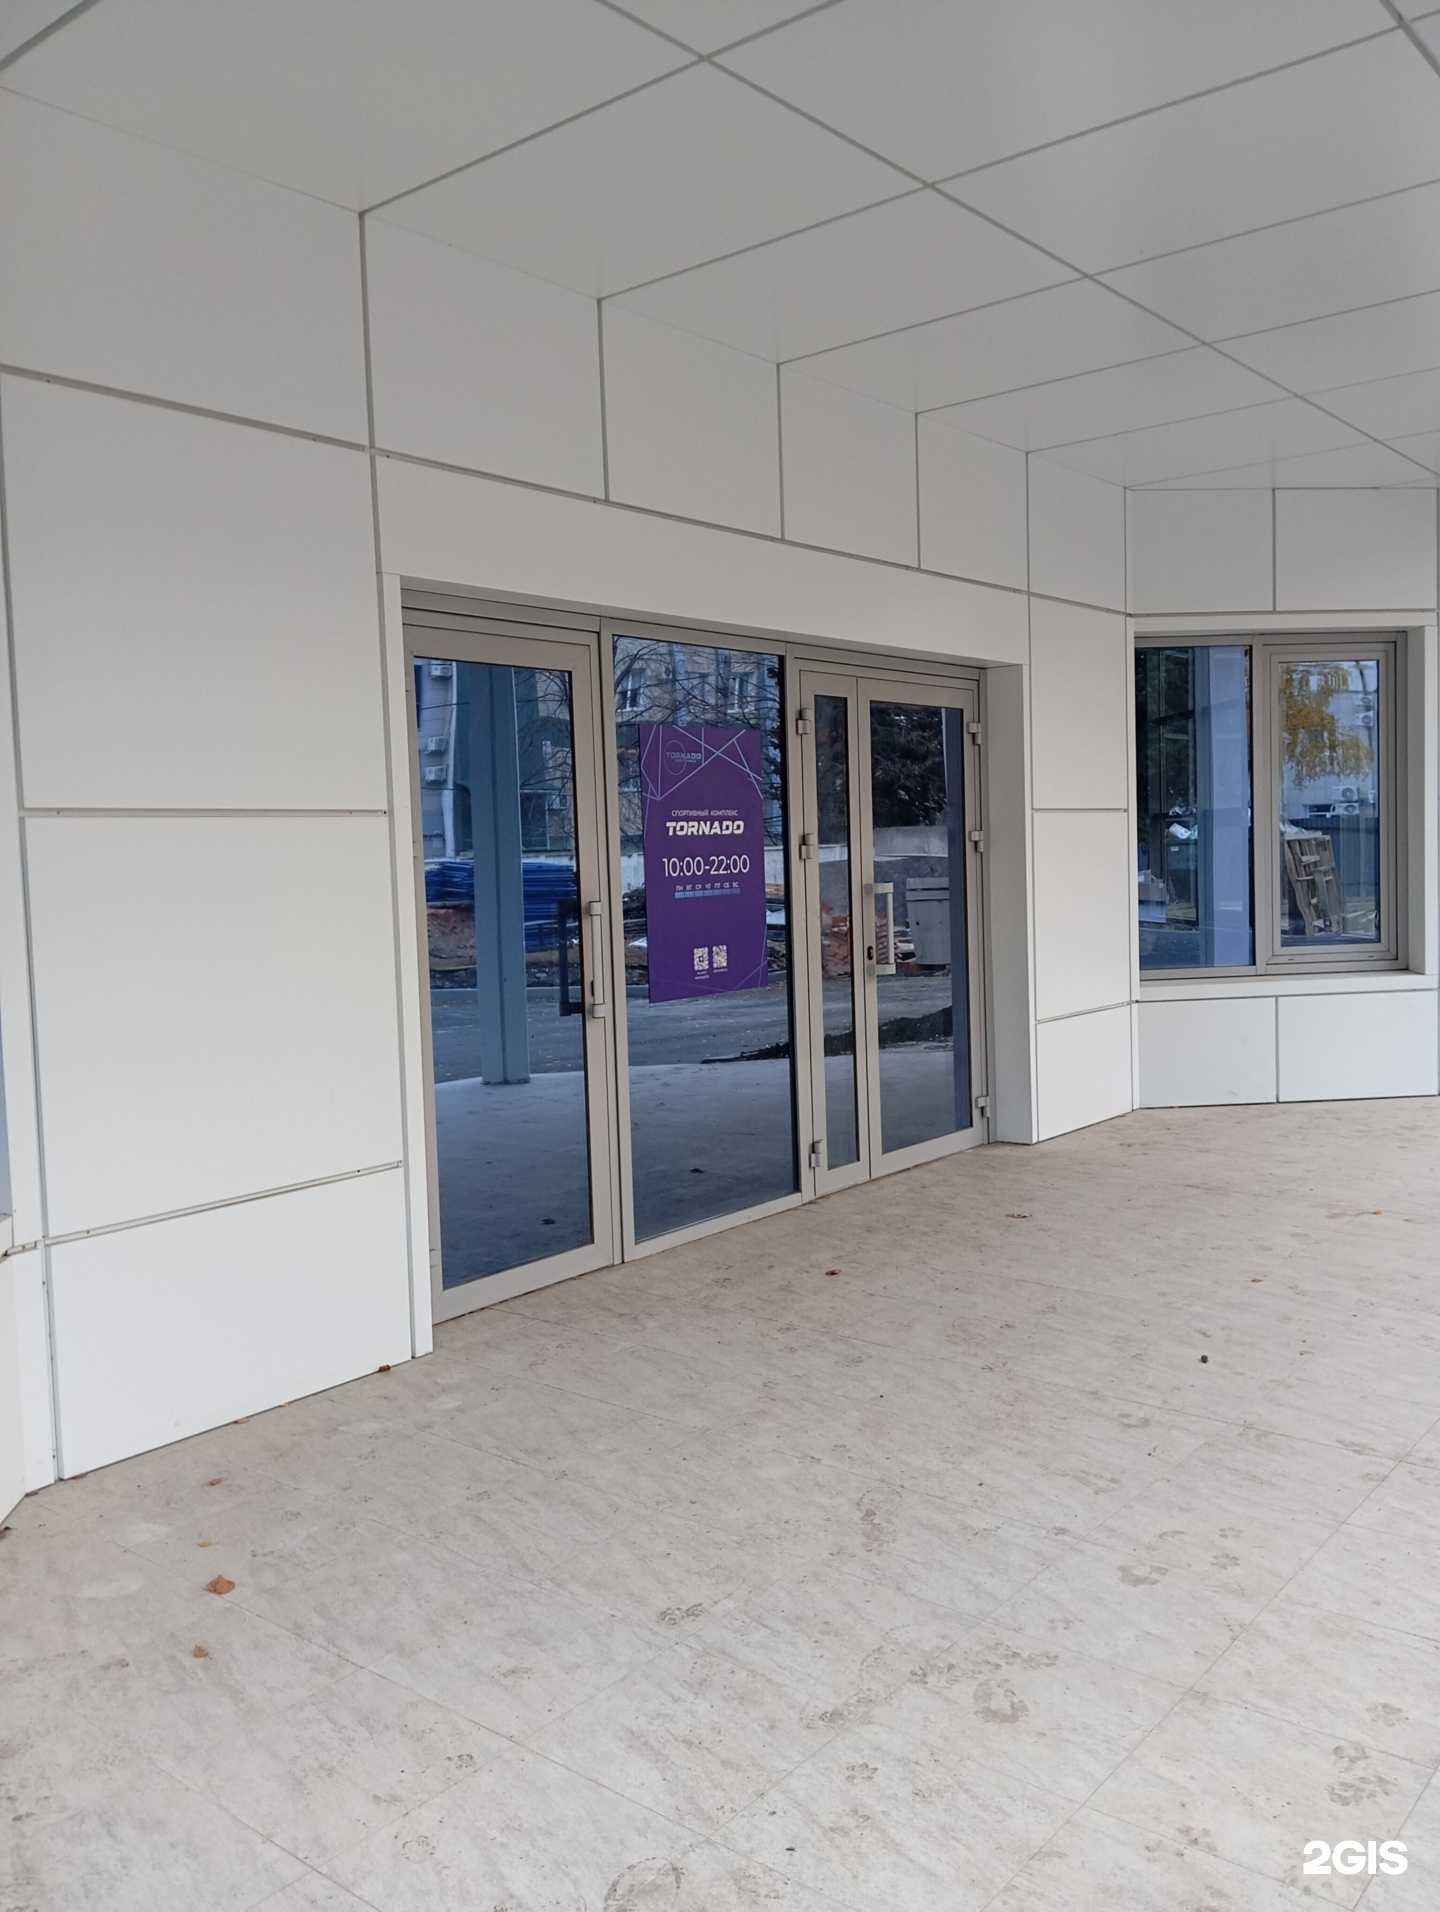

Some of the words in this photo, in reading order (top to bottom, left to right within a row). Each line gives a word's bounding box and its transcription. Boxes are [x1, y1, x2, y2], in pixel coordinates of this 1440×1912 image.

[665, 752, 701, 760] TORNADO
[671, 809, 708, 817] СПОРТИВНЫЙ
[710, 809, 738, 817] КОМПЛЕКС
[666, 820, 745, 836] TORNADO
[662, 854, 750, 877] 10:00-22:00
